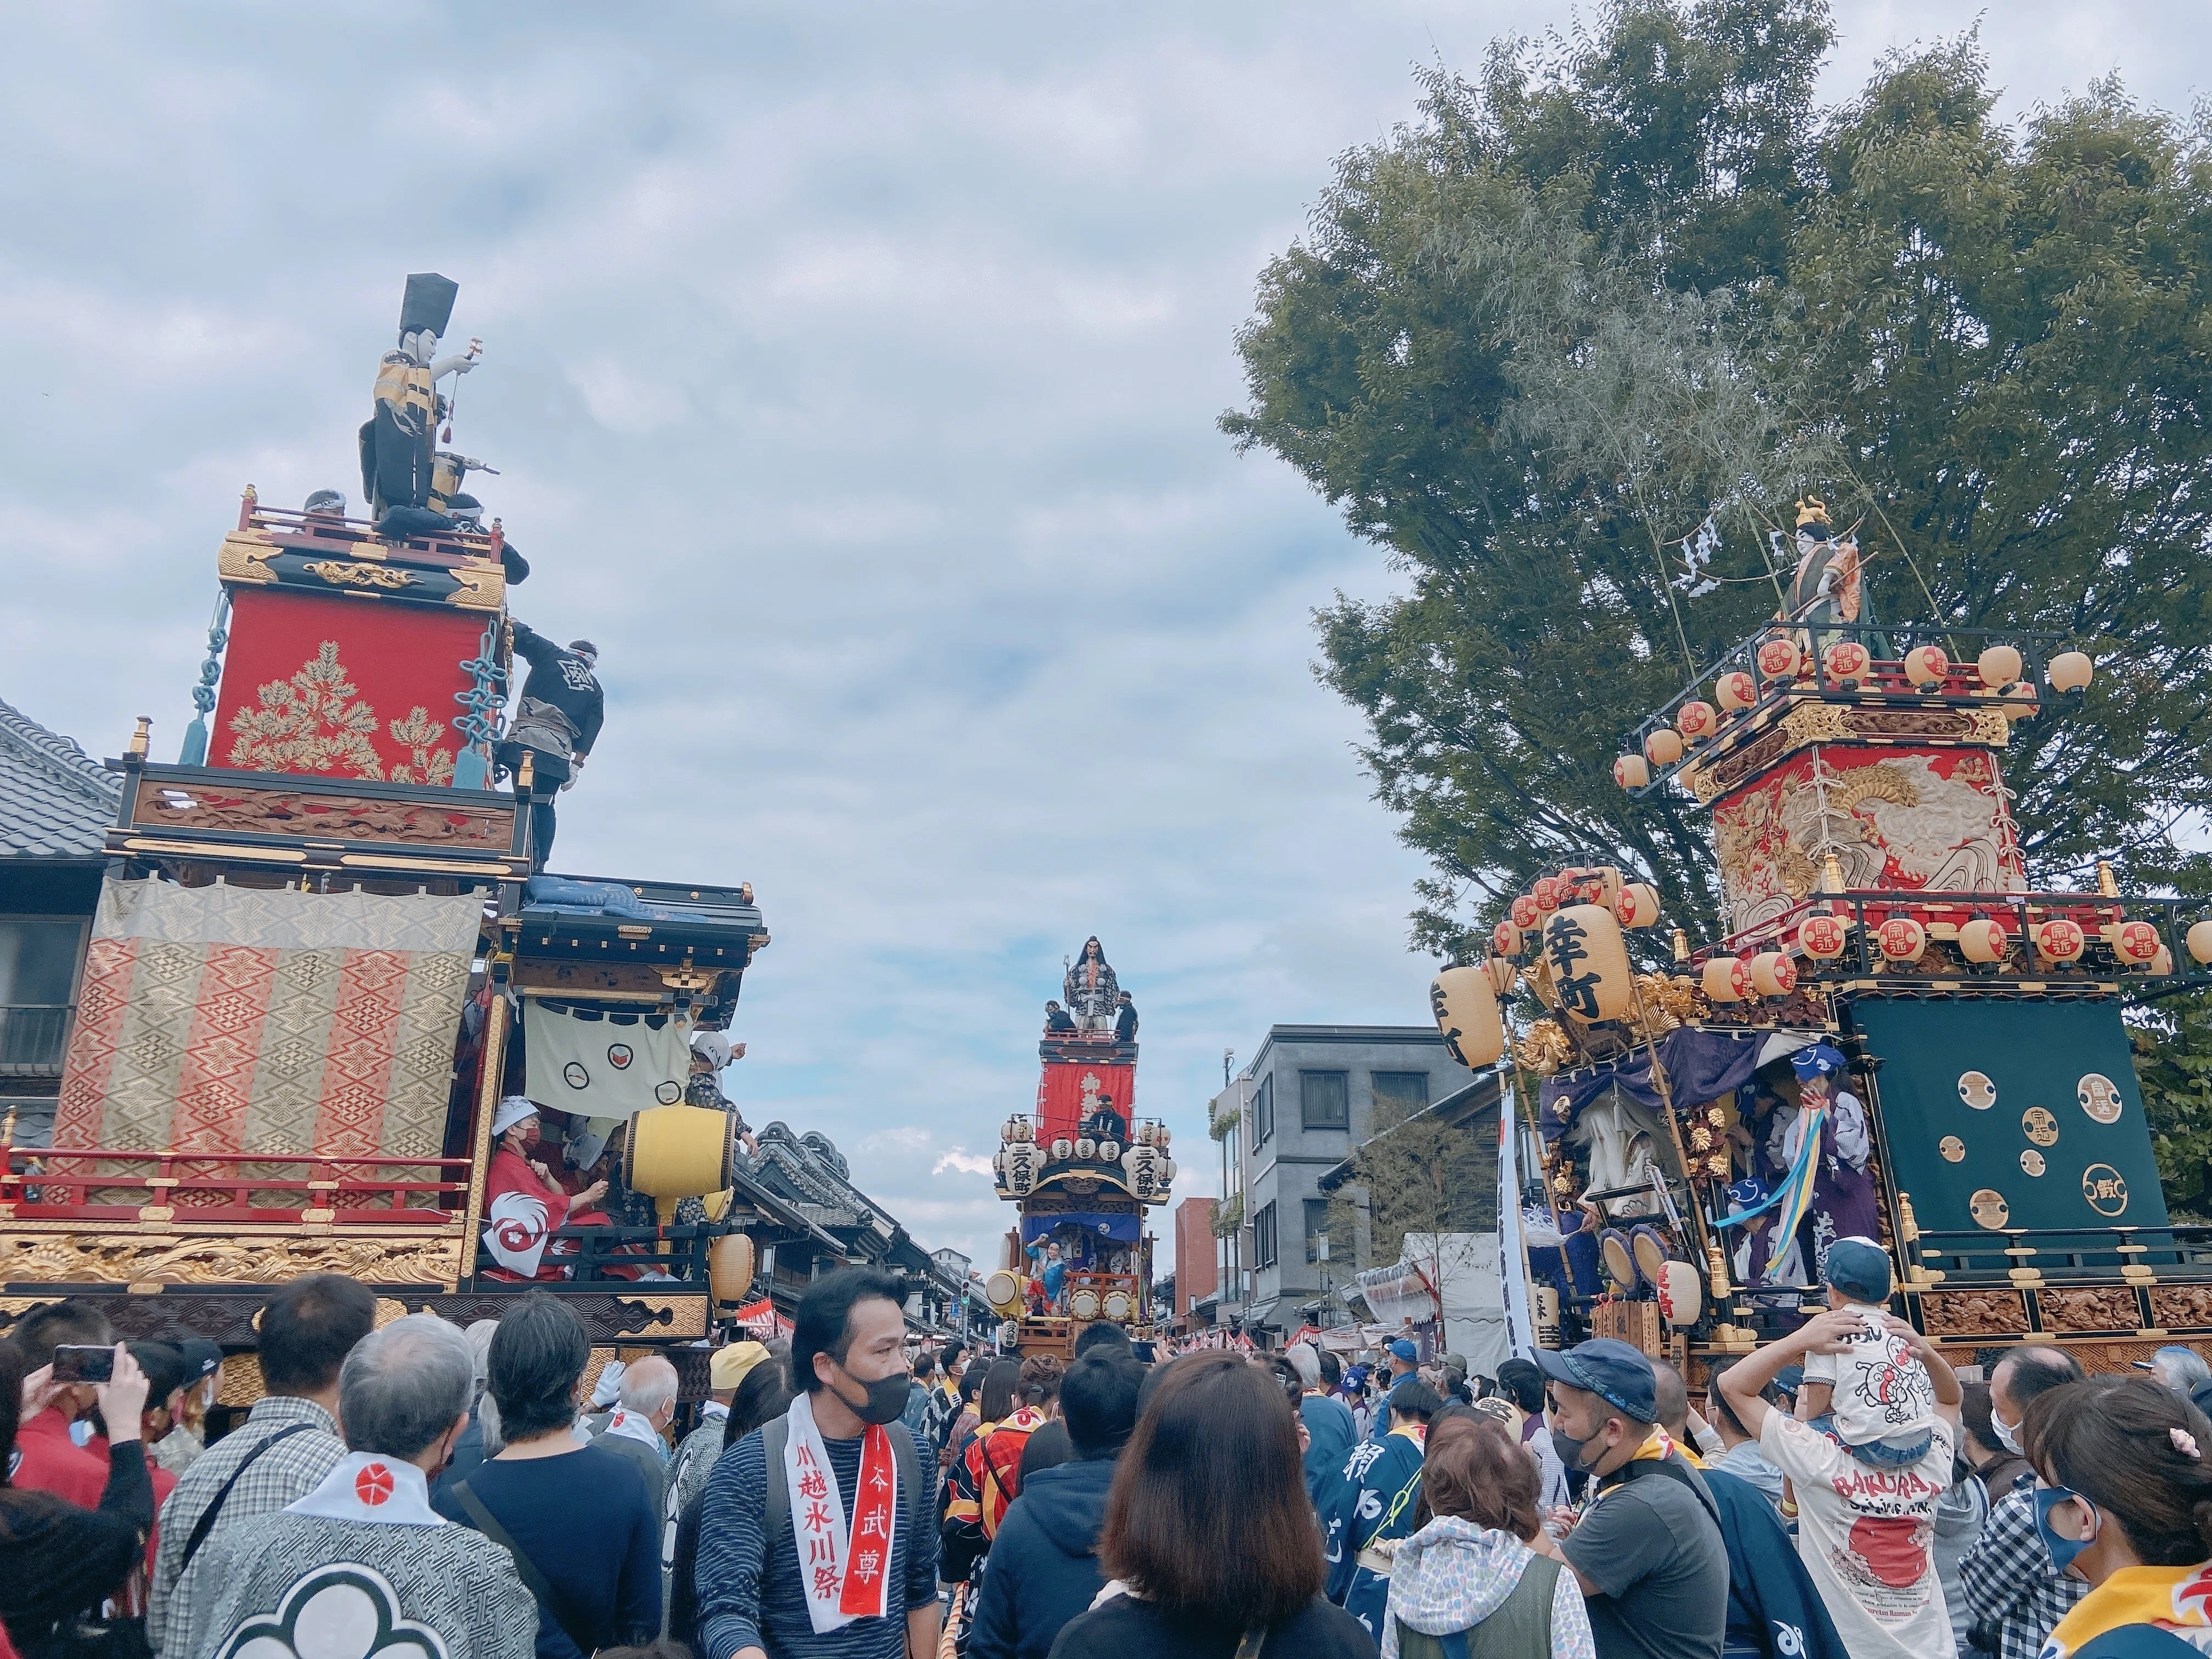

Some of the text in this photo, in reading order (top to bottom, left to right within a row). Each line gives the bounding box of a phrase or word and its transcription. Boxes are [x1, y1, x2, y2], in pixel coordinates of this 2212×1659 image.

[1815, 919, 1835, 952] 宗近
[1888, 923, 1908, 954] 宗近
[2051, 924, 2071, 955] 宗近
[2135, 926, 2153, 956] 宗近
[1544, 915, 1602, 1019] 幸町
[1058, 1141, 1068, 1158] 三久保町
[1080, 1141, 1090, 1158] 三久保町
[1106, 1142, 1116, 1160] 三久保町
[1012, 1146, 1031, 1194] 三久保町
[1135, 1149, 1155, 1198] 三久保町
[1005, 1322, 1017, 1347] 三久保町
[795, 1438, 843, 1601] 川越氷川祭
[854, 1426, 890, 1585] 本武尊
